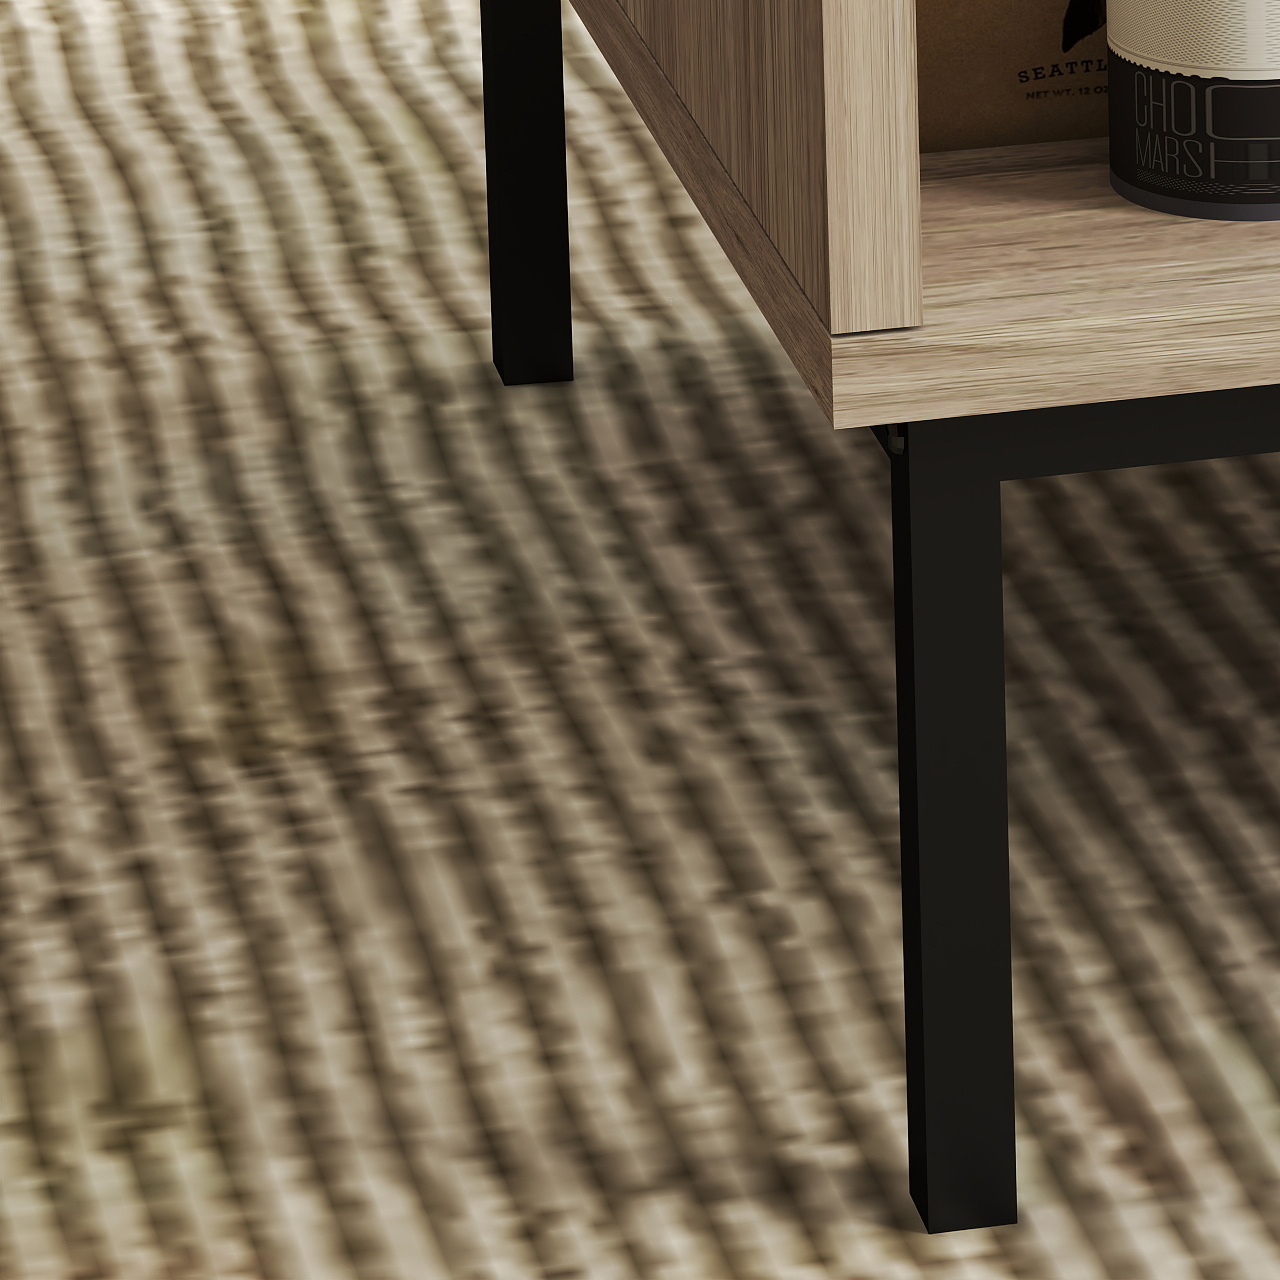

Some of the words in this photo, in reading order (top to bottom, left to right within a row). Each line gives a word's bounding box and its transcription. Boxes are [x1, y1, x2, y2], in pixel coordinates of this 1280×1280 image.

[1026, 91, 1049, 100] NET
[1053, 89, 1074, 97] WT.
[1079, 87, 1090, 95] 12
